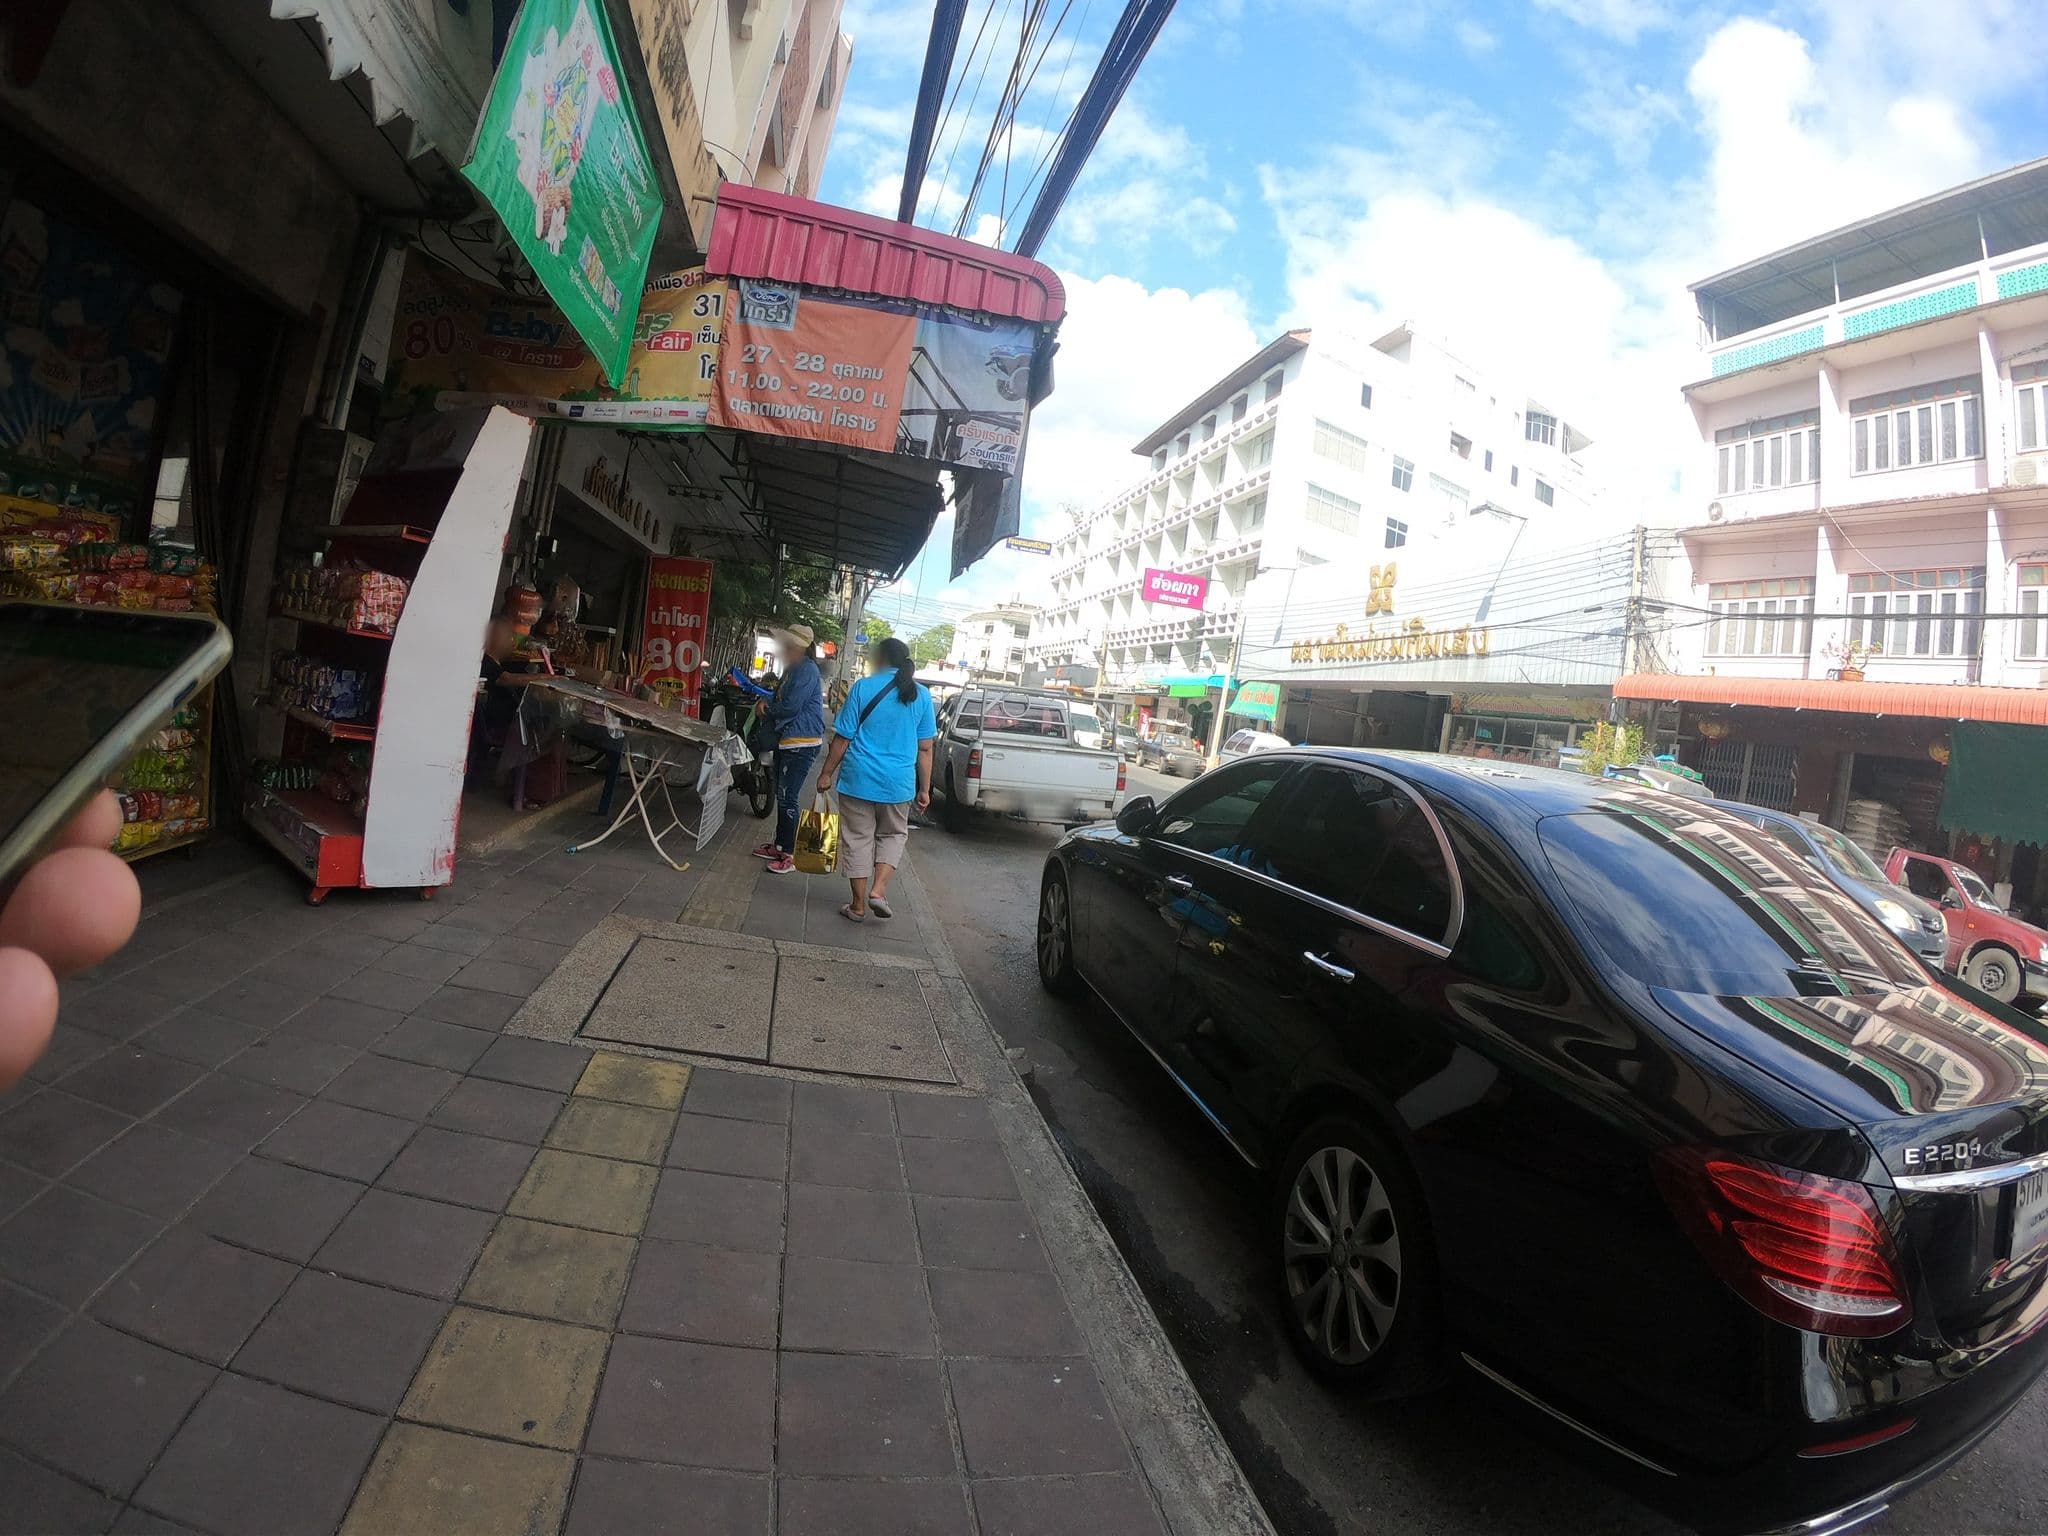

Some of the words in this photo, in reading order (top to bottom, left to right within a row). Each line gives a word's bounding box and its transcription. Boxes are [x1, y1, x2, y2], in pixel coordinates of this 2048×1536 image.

[694, 294, 721, 317] 31
[744, 305, 788, 323] แกร่ง
[651, 333, 690, 349] Fair
[741, 343, 773, 364] 27
[794, 351, 826, 373] 28
[832, 362, 884, 381] ตุลาคม
[728, 369, 782, 392] 11.00
[807, 381, 866, 403] 22.00
[873, 392, 889, 409] น.
[830, 406, 877, 432] โคราช
[648, 637, 701, 673] 80
